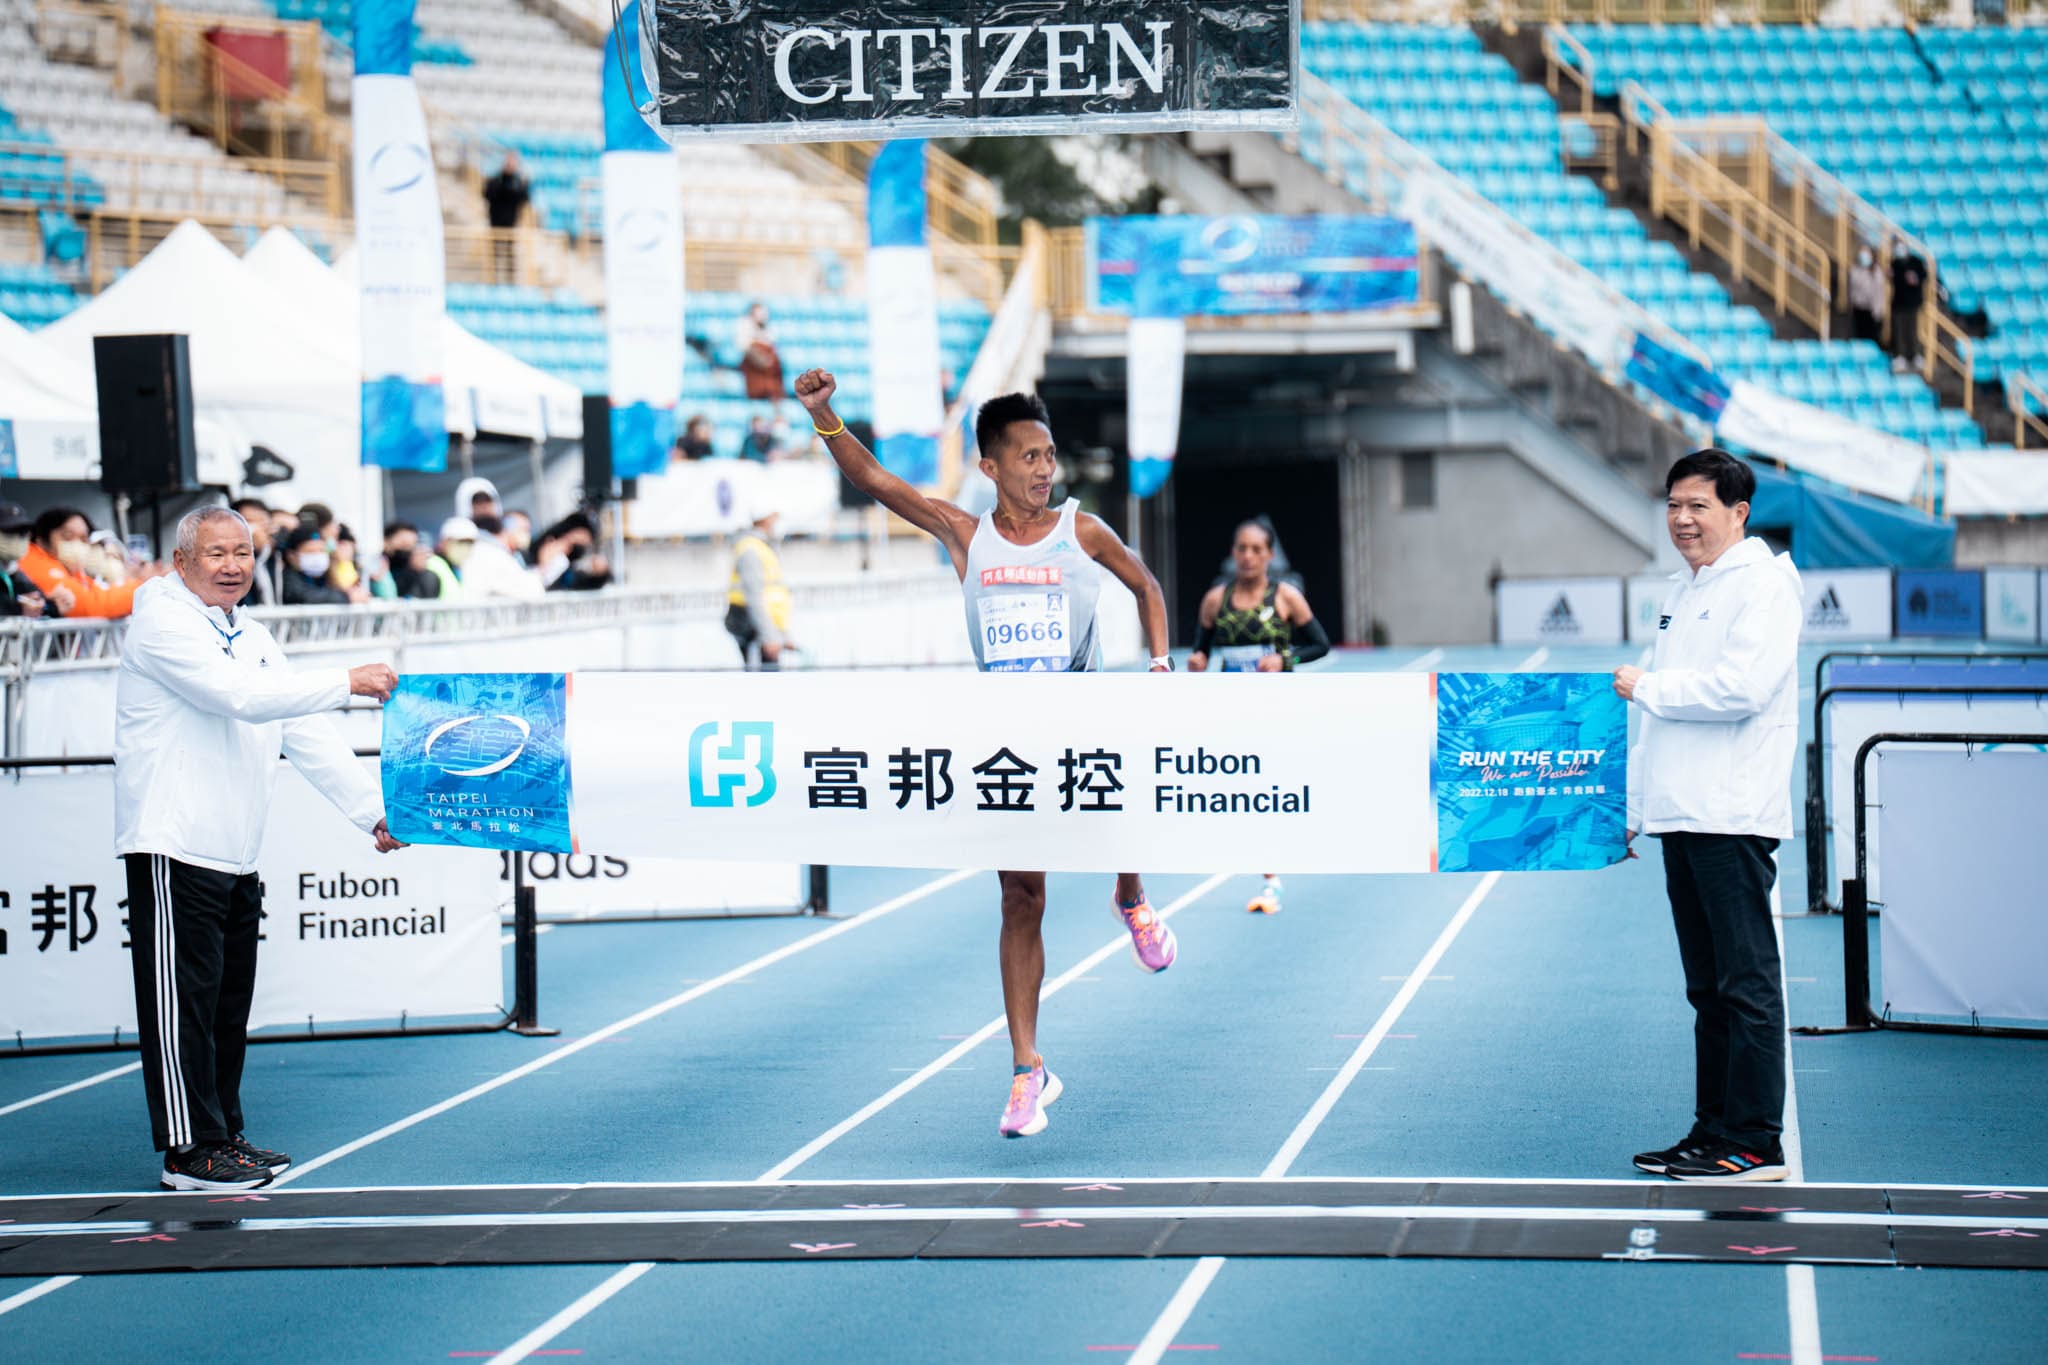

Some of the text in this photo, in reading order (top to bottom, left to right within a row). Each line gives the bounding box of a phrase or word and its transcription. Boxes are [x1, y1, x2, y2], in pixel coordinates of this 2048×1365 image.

[774, 22, 1172, 104] CITIZEN
[987, 621, 1063, 646] 09666
[1155, 747, 1260, 774] Fubon
[1459, 750, 1606, 766] RUN THE CITY
[1481, 766, 1505, 783] We
[1536, 759, 1588, 782] Possible
[804, 747, 1124, 812] 富邦金控
[1459, 788, 1508, 797] 2022.12.18
[427, 793, 488, 803] TAIPEI
[1155, 785, 1309, 813] Financial
[429, 808, 534, 817] MARATHON
[299, 872, 399, 900] Fubon
[299, 907, 445, 940] Financial
